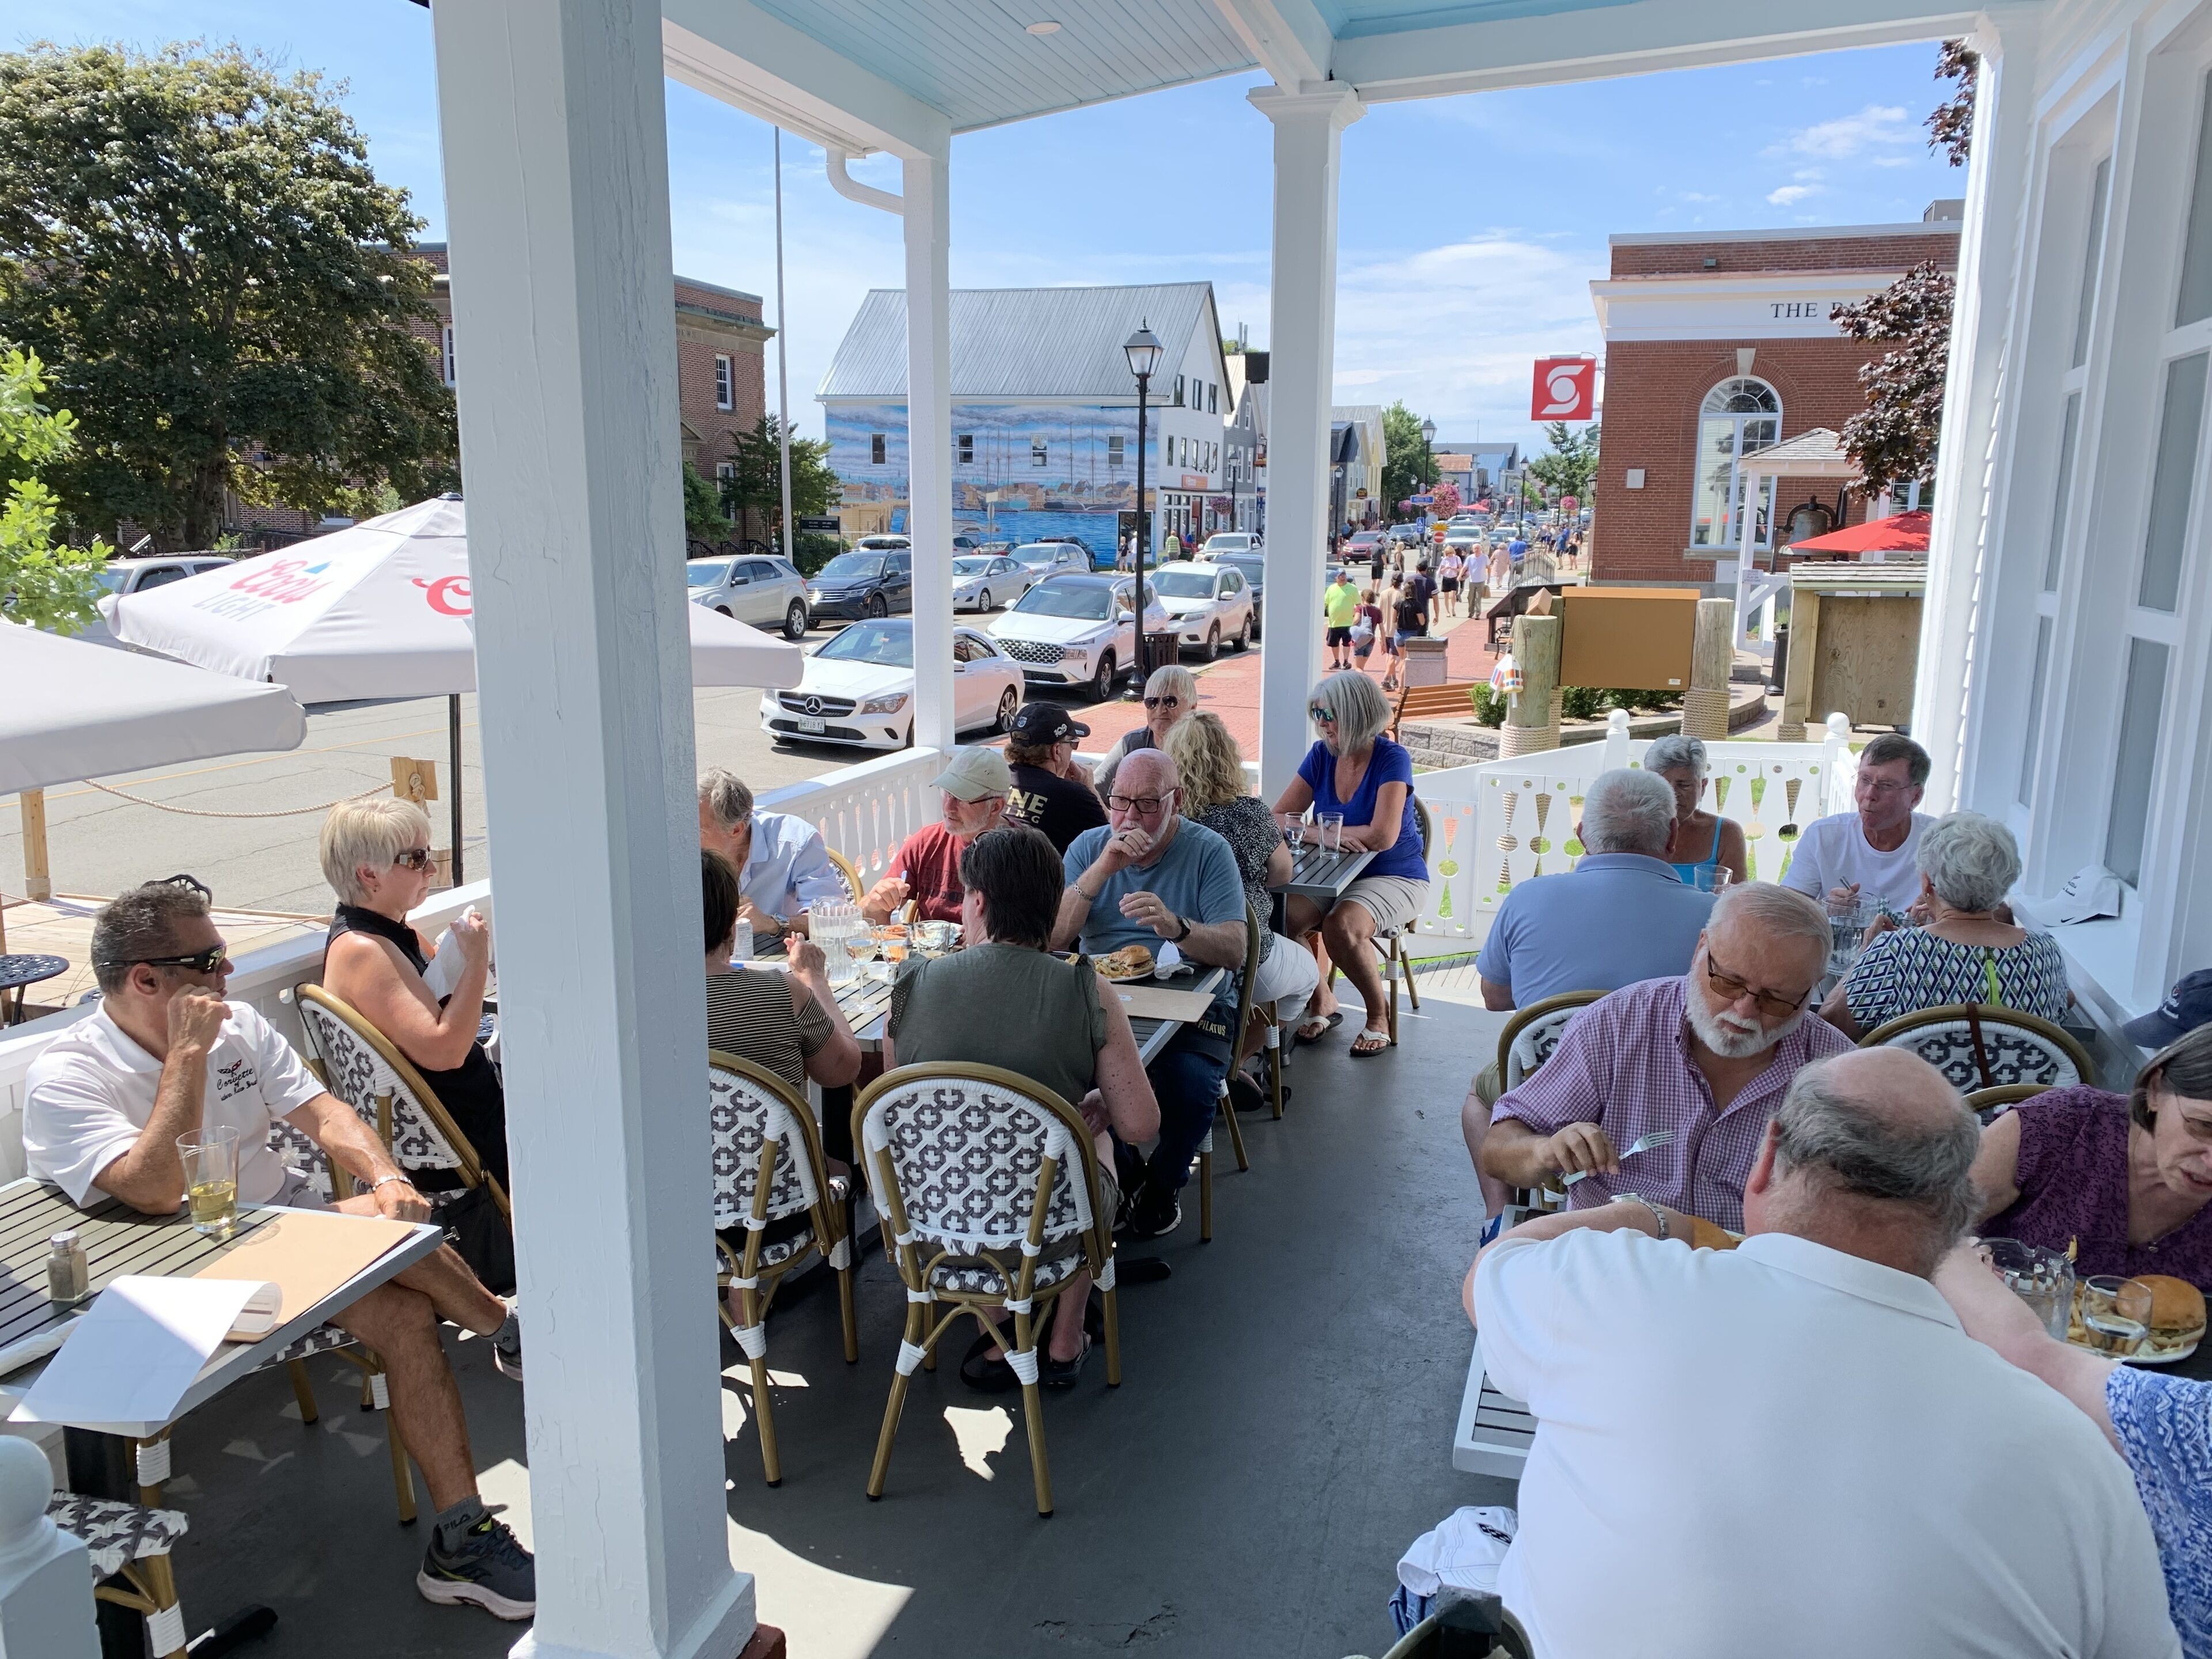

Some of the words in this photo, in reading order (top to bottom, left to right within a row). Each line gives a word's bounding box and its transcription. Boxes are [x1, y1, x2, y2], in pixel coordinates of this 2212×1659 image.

[1771, 303, 1817, 317] THE
[229, 559, 335, 604] Coors
[192, 591, 277, 622] LIGHT
[1006, 786, 1048, 815] NE
[1198, 1020, 1226, 1036] PILATUS
[443, 1513, 471, 1531] FILA
